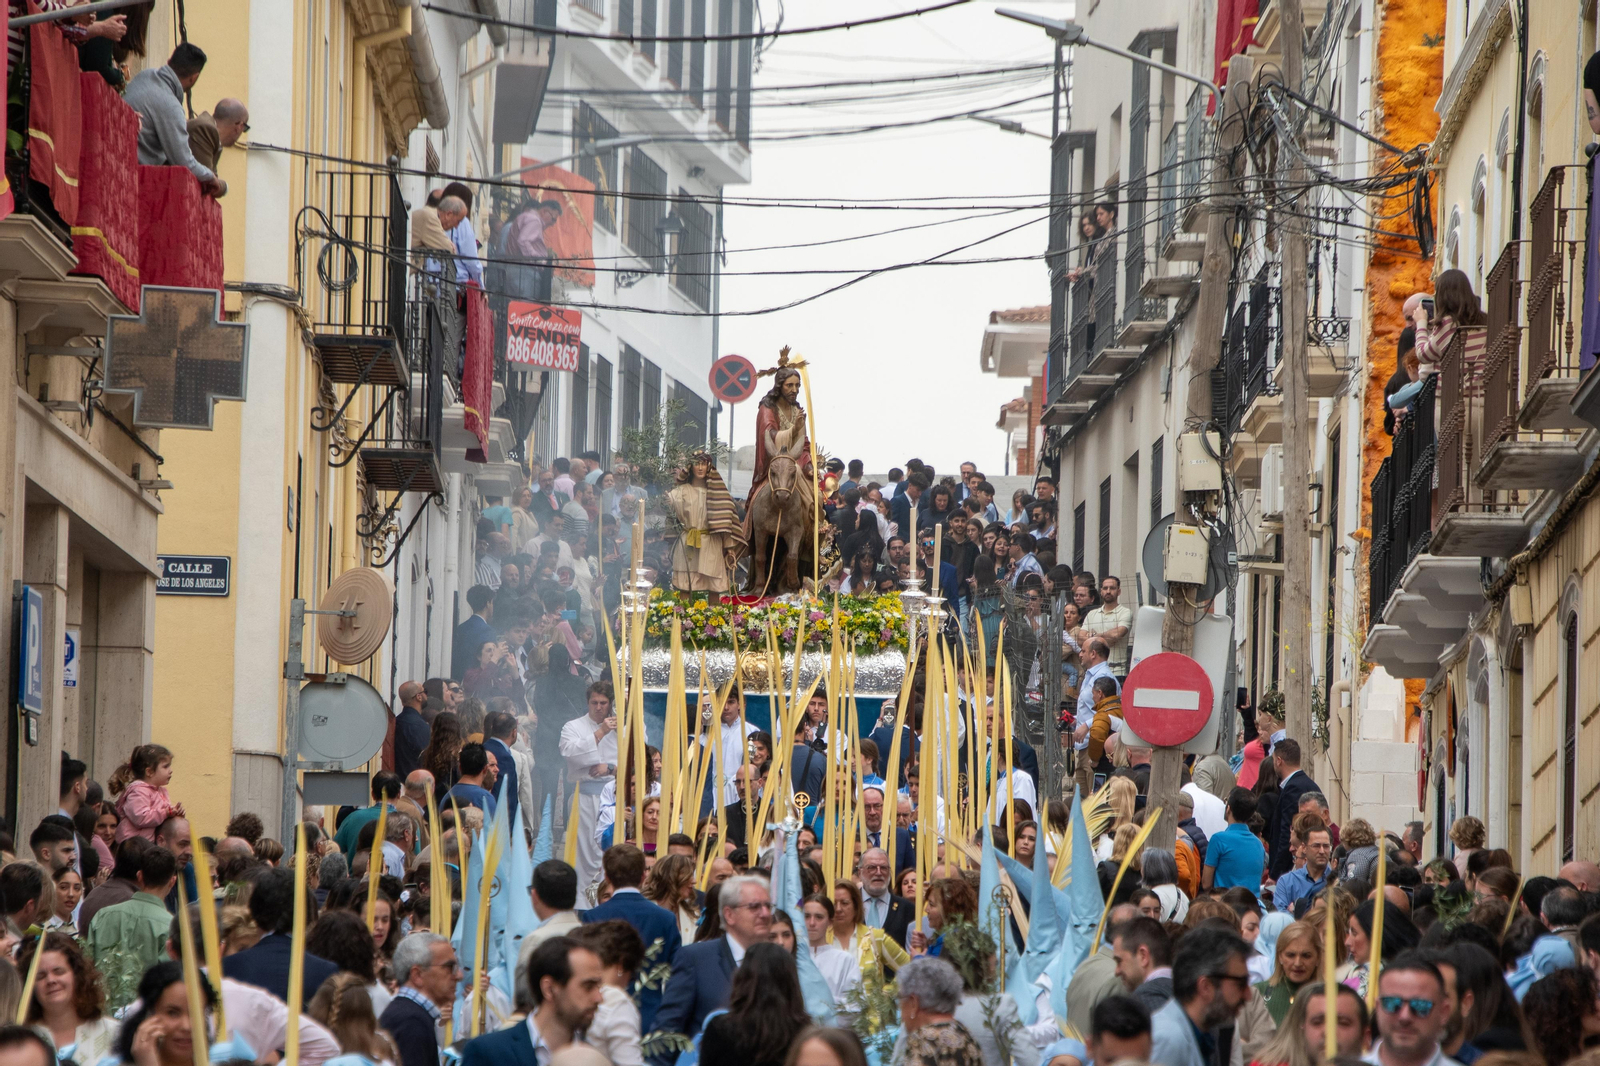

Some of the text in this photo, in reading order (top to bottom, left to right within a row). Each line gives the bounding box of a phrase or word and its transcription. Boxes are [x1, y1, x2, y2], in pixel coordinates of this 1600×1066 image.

[508, 324, 579, 348] VENDE
[508, 335, 578, 370] 686 408 363
[168, 563, 213, 574] CALLE
[156, 577, 225, 588] OSE DE LOS ANGELES
[28, 604, 39, 695] P
